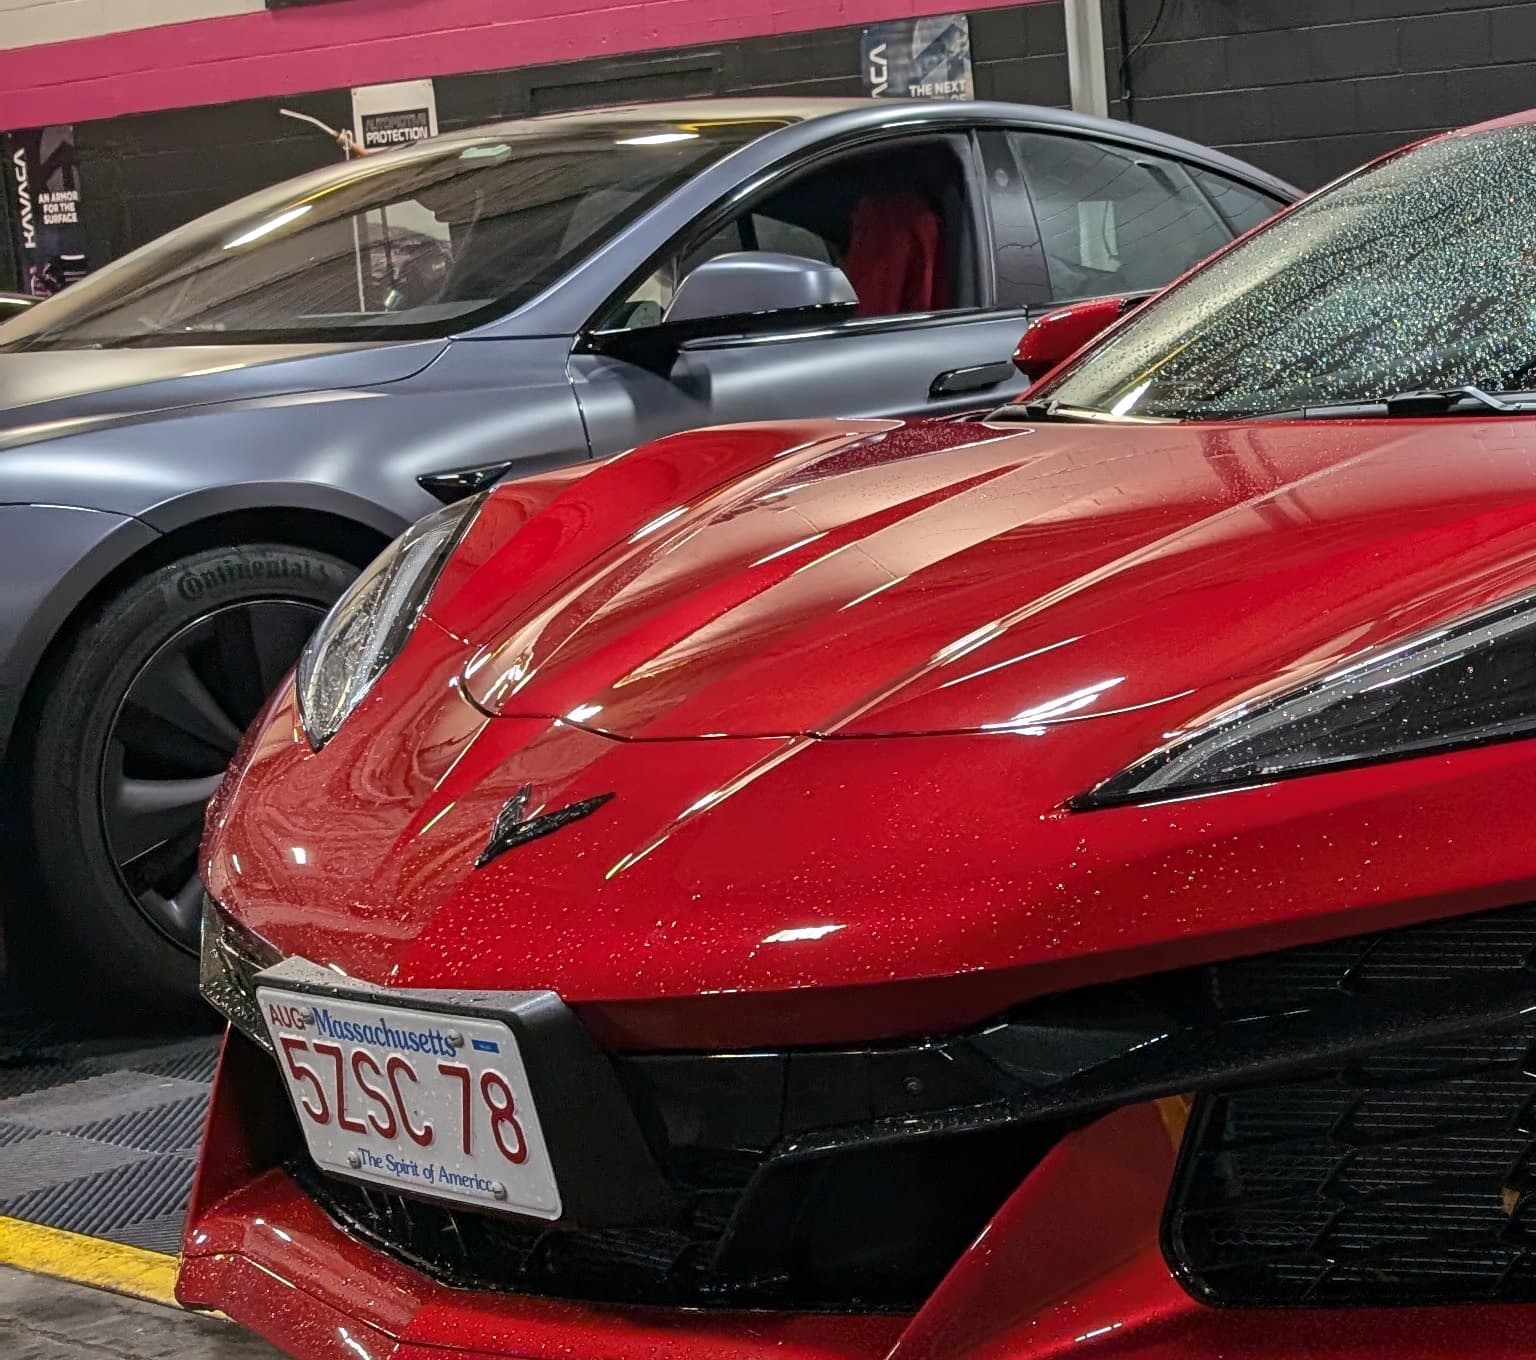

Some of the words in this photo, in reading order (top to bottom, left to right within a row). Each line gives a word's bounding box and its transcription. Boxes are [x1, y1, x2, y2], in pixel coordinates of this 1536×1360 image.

[909, 84, 933, 97] THE
[935, 80, 966, 93] NEXT
[366, 126, 428, 145] PROTECTION
[38, 193, 50, 204] AN
[51, 191, 79, 203] ARMOR
[43, 204, 59, 214] FOR
[60, 202, 75, 212] THE
[43, 213, 78, 225] SURFACE
[177, 559, 310, 601] Continental
[269, 1003, 306, 1030] AUG
[312, 1006, 457, 1057] Massachusetts
[279, 1037, 434, 1147] 5ZSC
[438, 1063, 527, 1164] 78
[358, 1147, 383, 1169] The
[386, 1153, 419, 1176] Spirit
[423, 1163, 434, 1184] of
